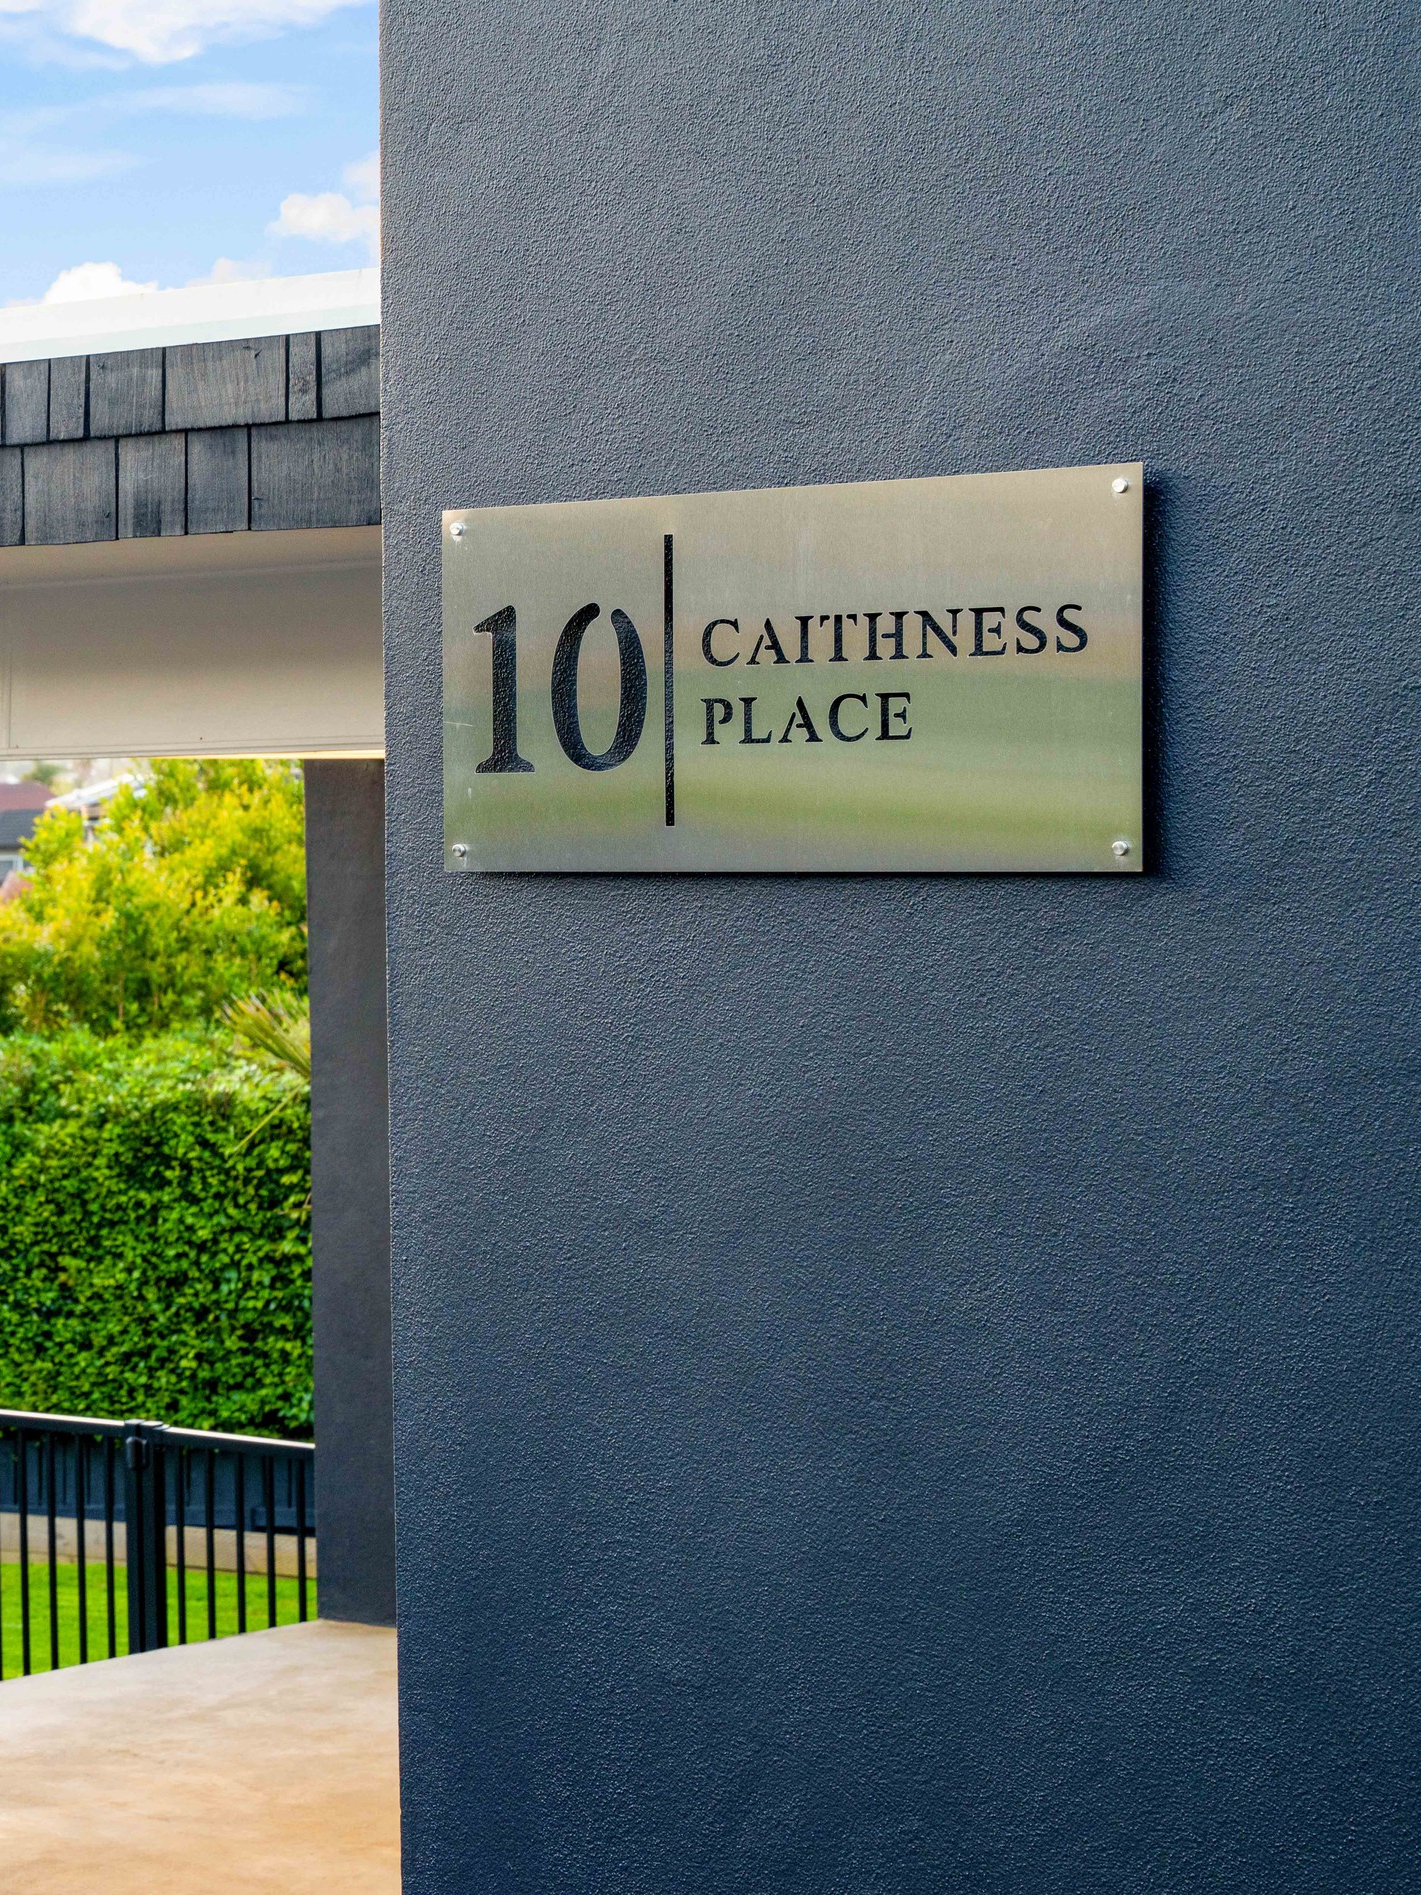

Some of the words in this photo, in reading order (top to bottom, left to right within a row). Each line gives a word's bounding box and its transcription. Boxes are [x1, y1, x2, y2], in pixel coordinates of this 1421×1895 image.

[700, 603, 1090, 668] CAITHNESS
[473, 602, 648, 774] 10
[699, 691, 913, 746] PLACE
